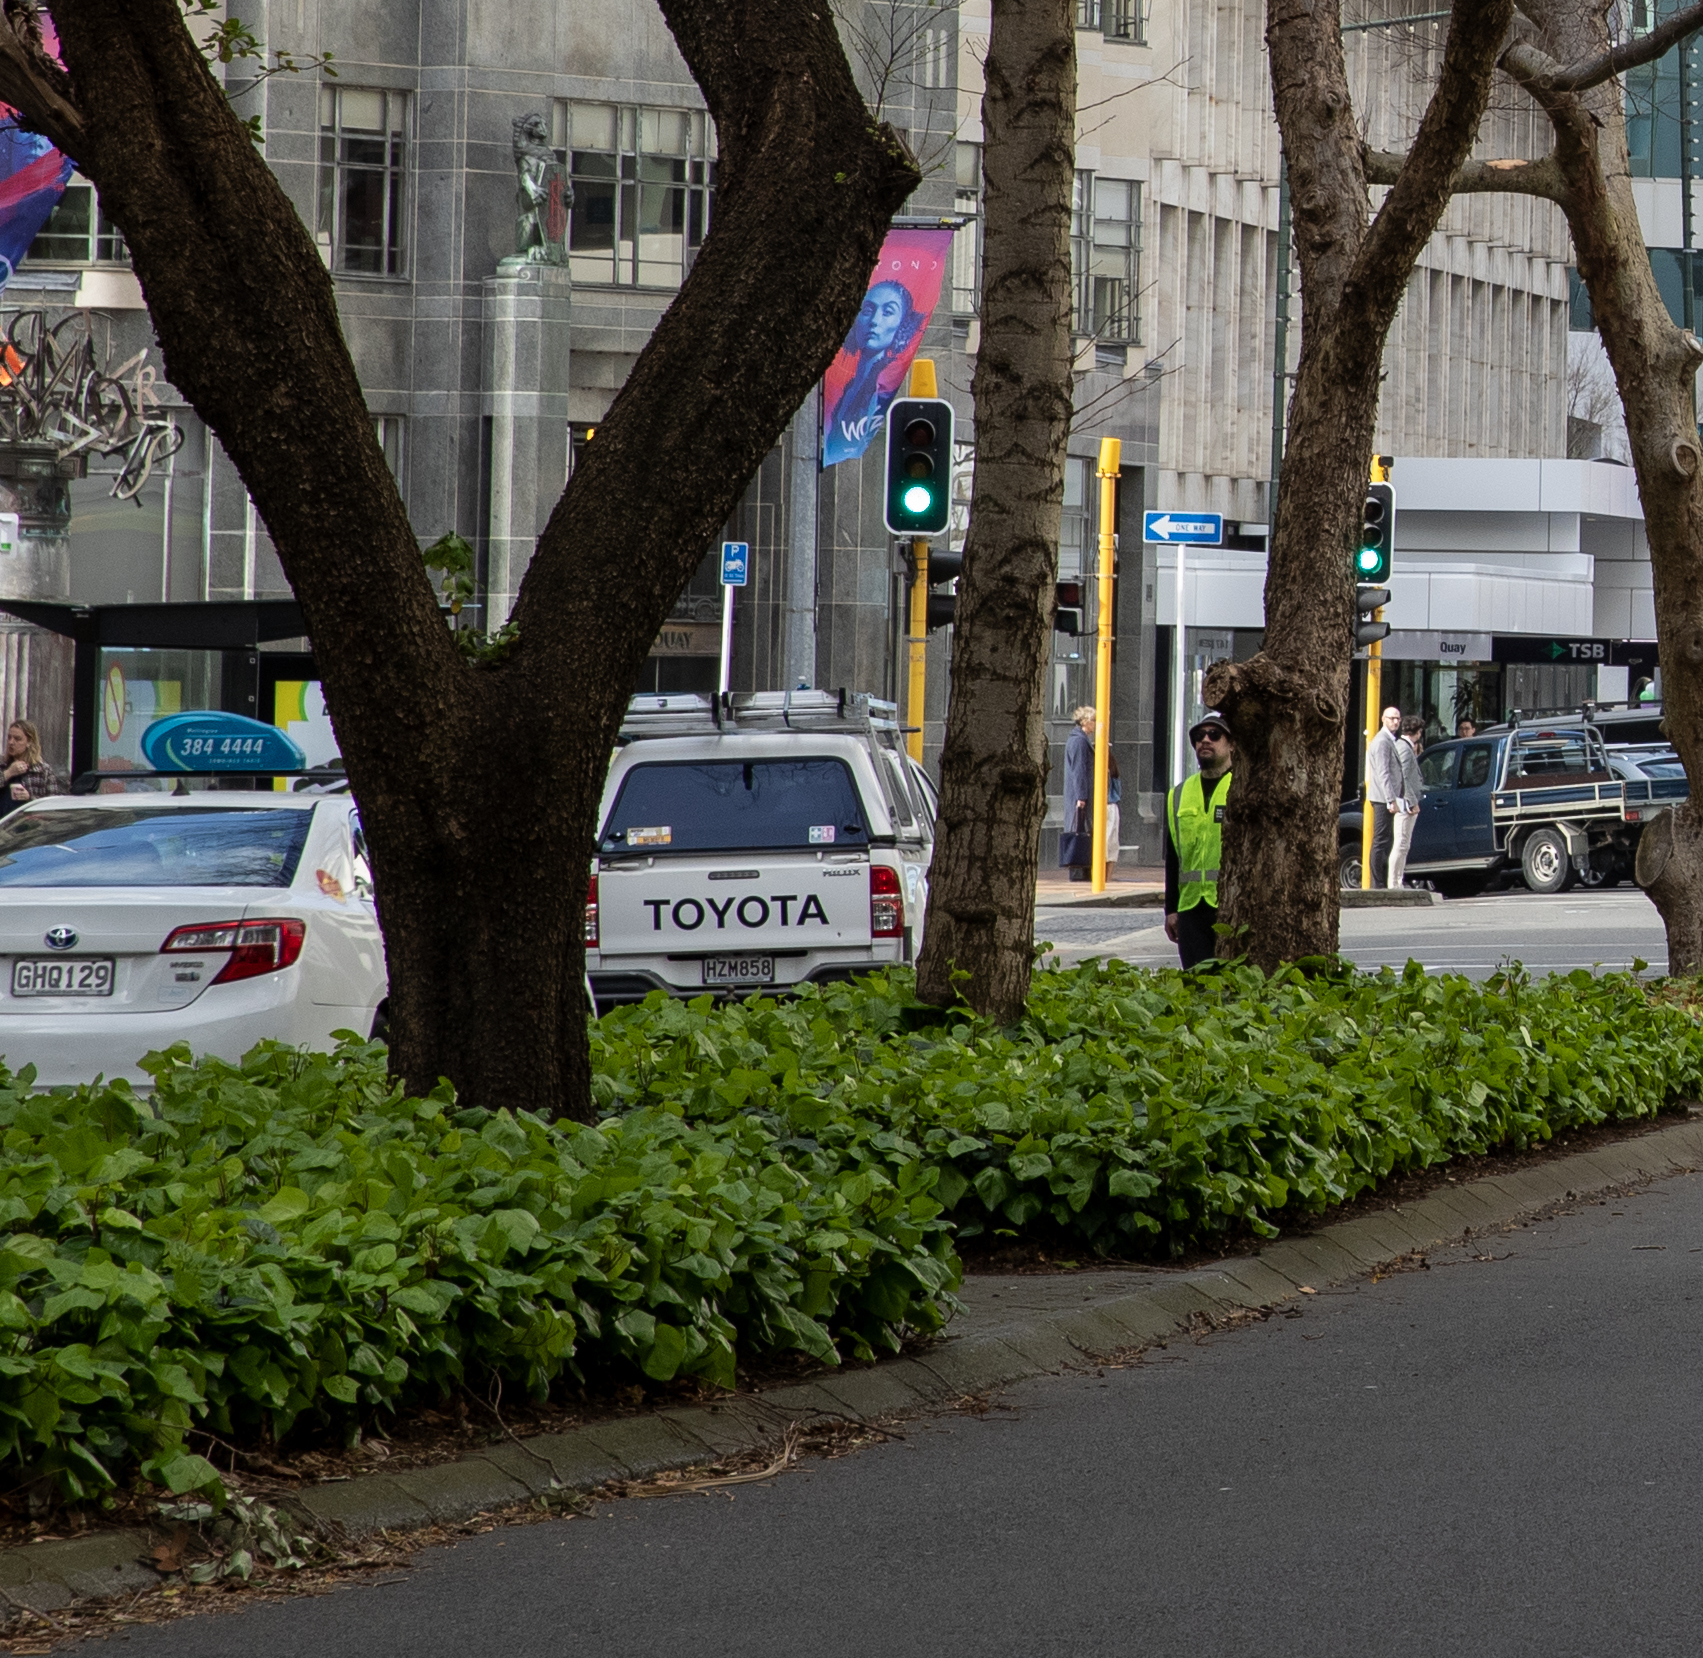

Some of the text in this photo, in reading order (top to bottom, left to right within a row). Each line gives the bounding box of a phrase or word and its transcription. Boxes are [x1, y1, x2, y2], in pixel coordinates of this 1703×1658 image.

[1175, 523, 1207, 532] ONE WAY
[1439, 642, 1467, 655] Quay
[1568, 643, 1605, 658] TSB
[181, 738, 264, 756] 384 4444
[643, 894, 830, 931] TOYOTA
[16, 964, 110, 990] GHQ129
[705, 958, 772, 979] HZM858
